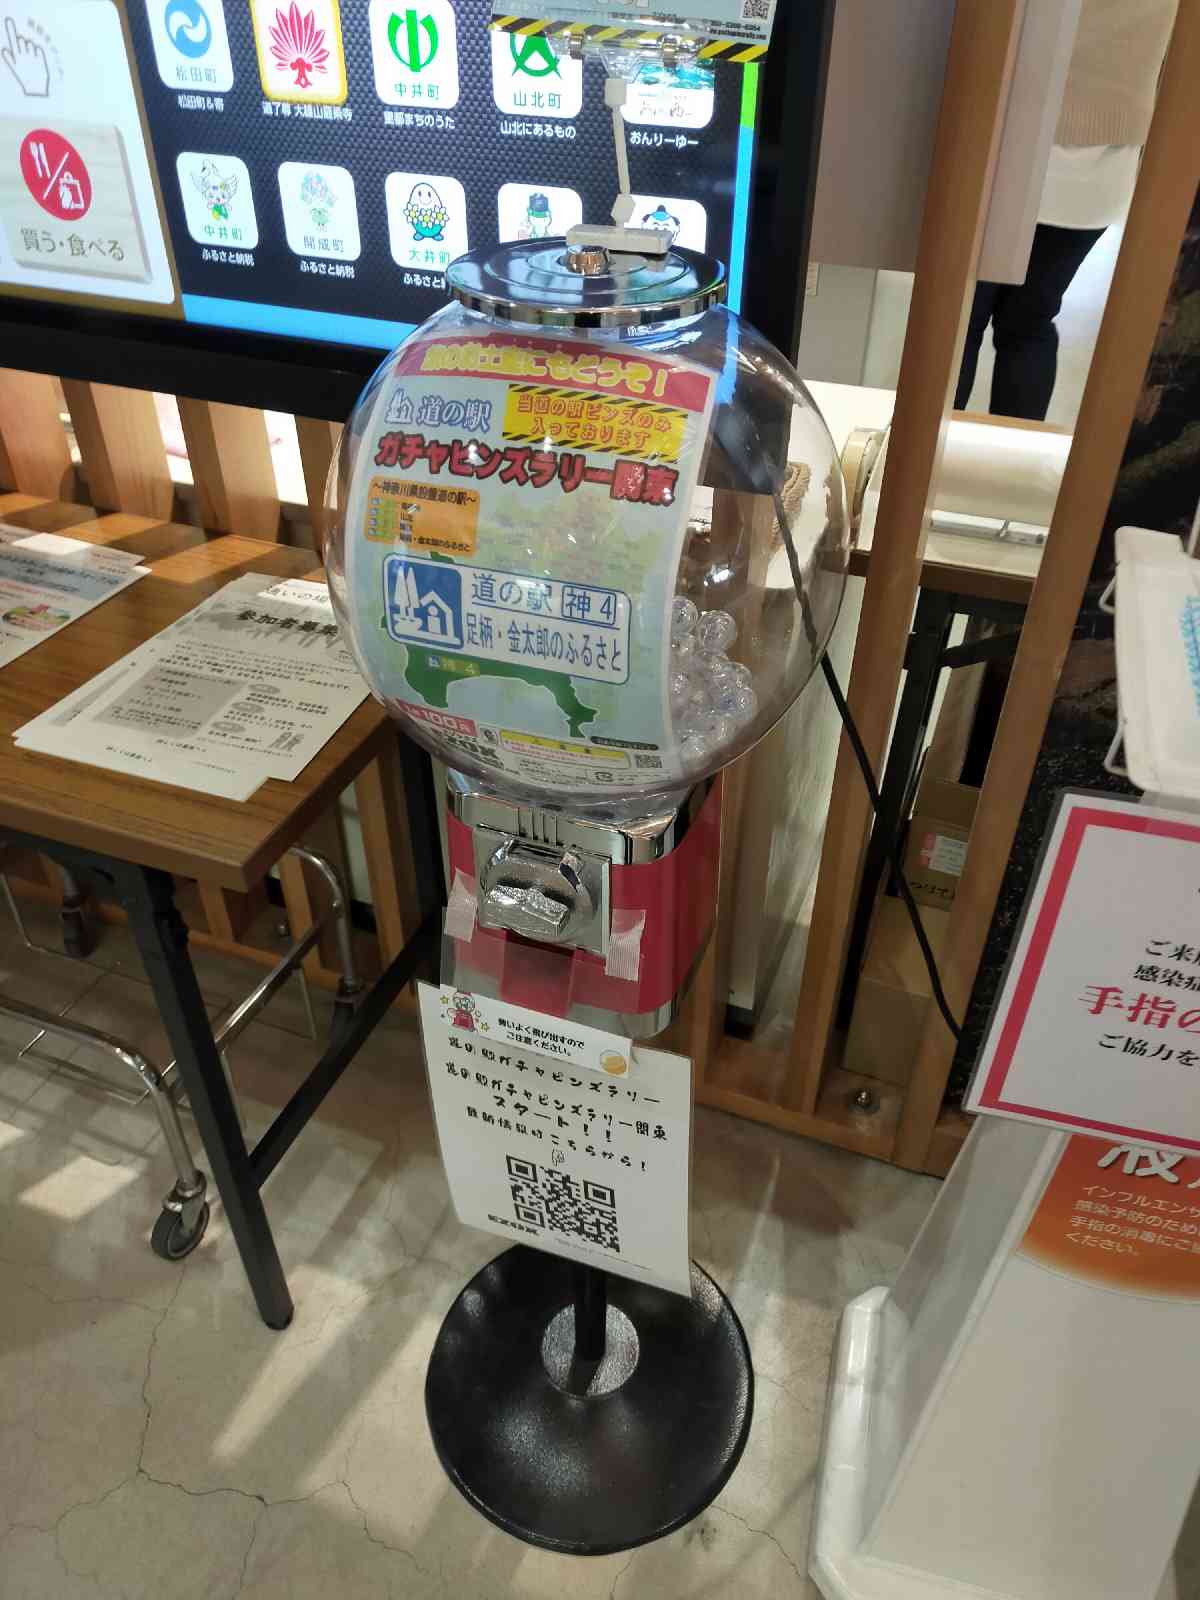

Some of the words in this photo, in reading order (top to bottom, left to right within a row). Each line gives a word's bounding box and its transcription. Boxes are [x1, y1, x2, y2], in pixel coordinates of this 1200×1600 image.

[394, 82, 440, 101] 中井町
[513, 91, 562, 109] 山北町
[500, 120, 576, 139] 山北にあるもの
[629, 131, 699, 150] おんりーゆー
[20, 227, 125, 262] 買う・食べる
[202, 248, 255, 267] ふるさと納税
[408, 248, 452, 265] 大井町
[300, 260, 356, 279] ふるさと納税
[403, 272, 447, 290] ふるさと
[416, 394, 493, 434] 道の駅
[530, 417, 651, 449] 入っております
[471, 572, 553, 613] 道の駅
[466, 612, 622, 672] 足柄・金太郎のふるさと
[498, 1017, 585, 1050] 勢いよく飛び出すので
[506, 1031, 571, 1057] ご注意ください。
